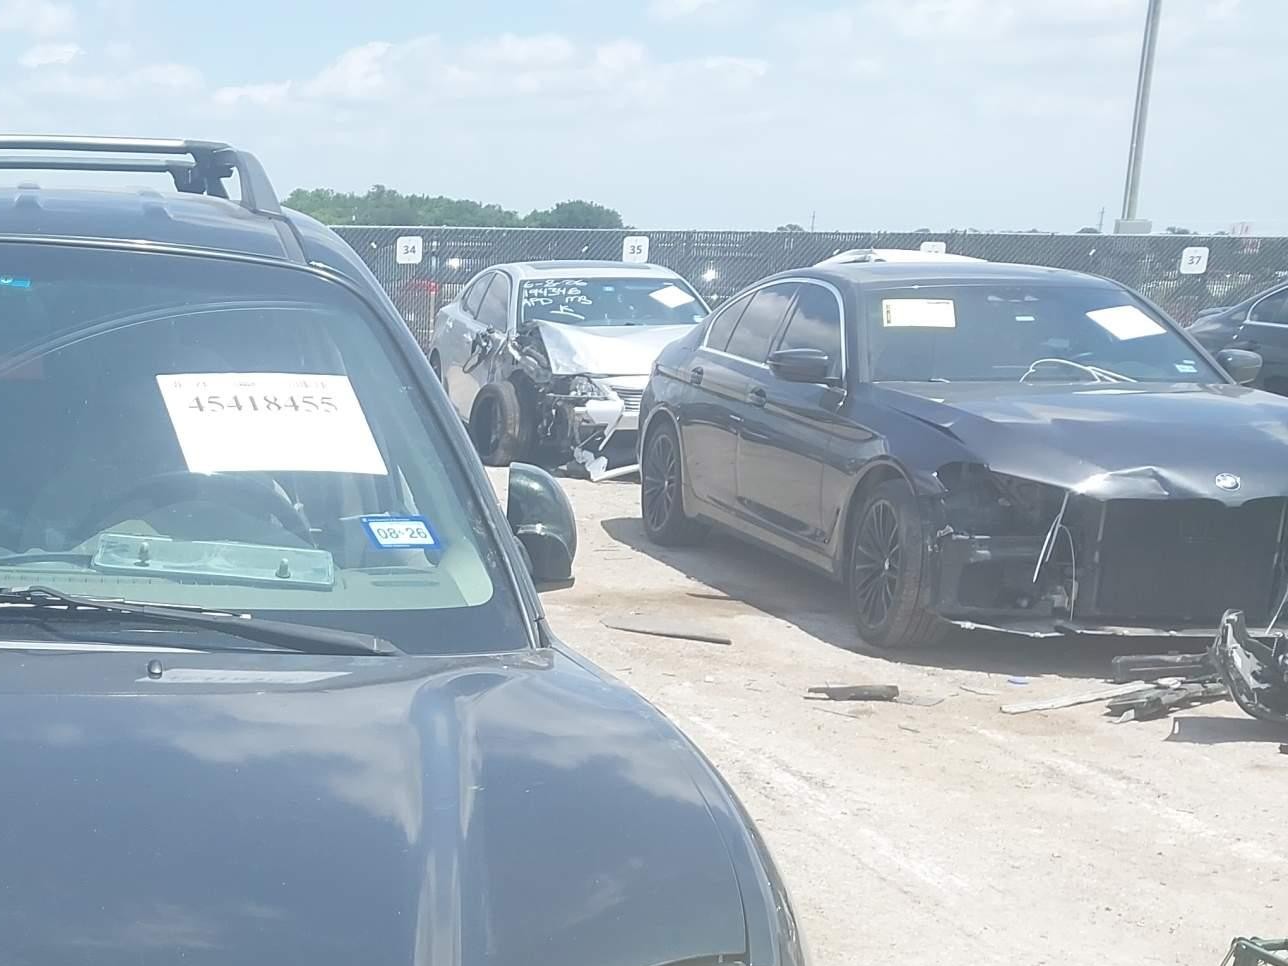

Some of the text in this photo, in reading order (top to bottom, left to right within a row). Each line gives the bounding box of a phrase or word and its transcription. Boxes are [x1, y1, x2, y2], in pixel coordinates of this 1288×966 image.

[403, 245, 416, 255] 34
[629, 245, 642, 254] 35
[1188, 255, 1201, 265] 37
[188, 395, 339, 413] 45418455
